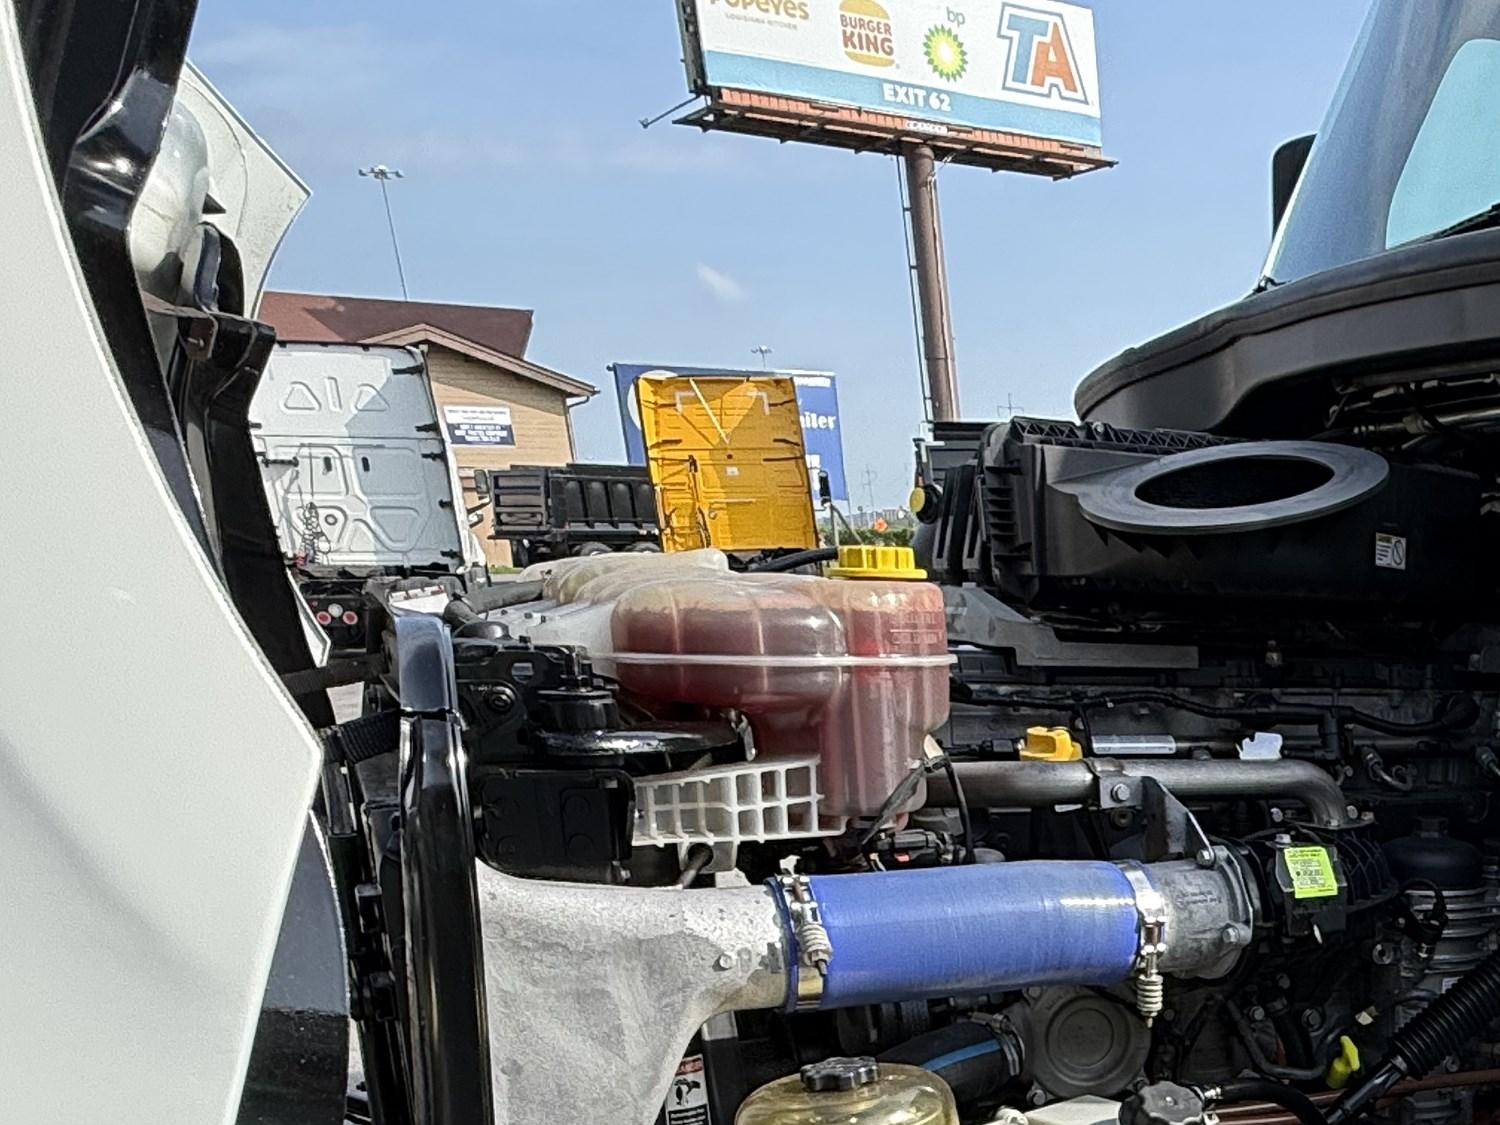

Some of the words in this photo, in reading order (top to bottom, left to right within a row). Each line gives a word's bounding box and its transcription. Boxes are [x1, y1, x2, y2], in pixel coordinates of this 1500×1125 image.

[710, 0, 809, 20] eyes
[946, 6, 966, 27] bp
[840, 14, 892, 36] BURGER
[842, 29, 894, 56] KING
[1007, 14, 1078, 93] TA
[883, 83, 926, 107] EXIT
[929, 92, 952, 112] 62
